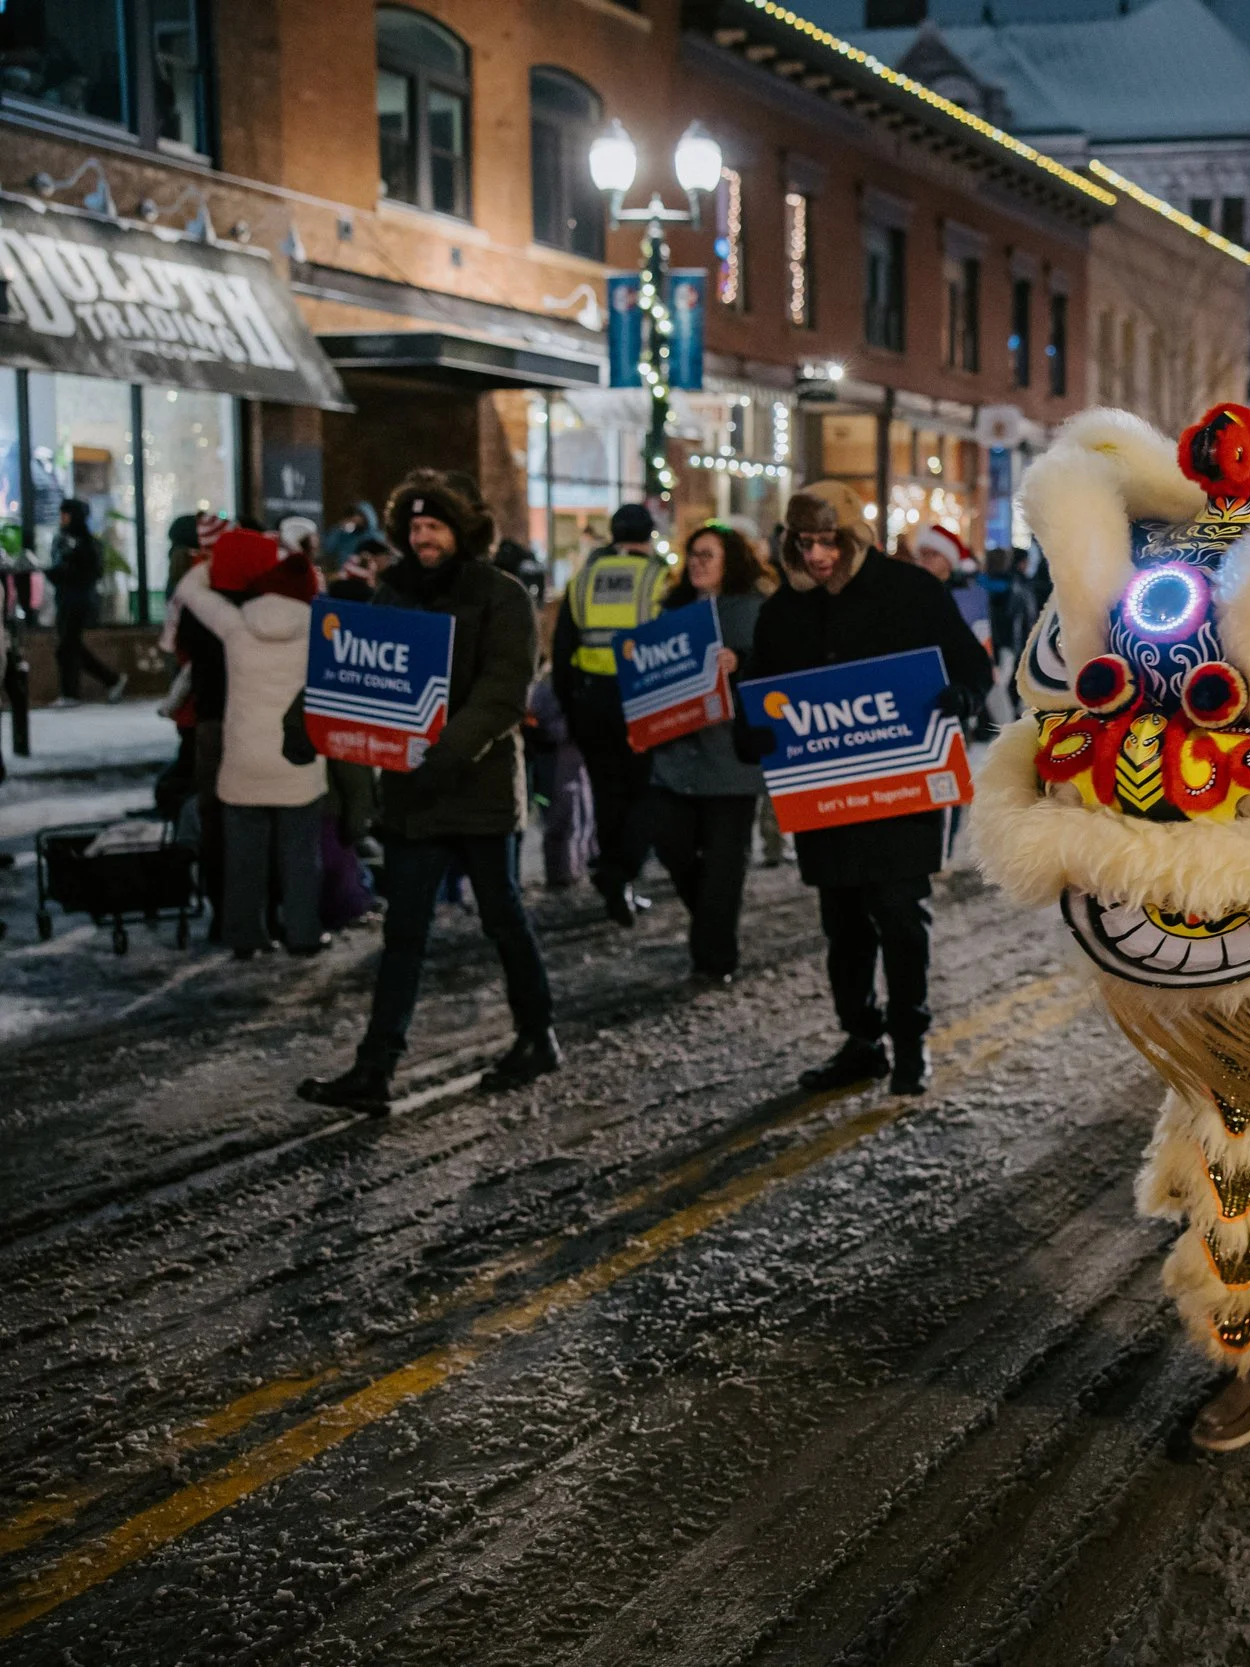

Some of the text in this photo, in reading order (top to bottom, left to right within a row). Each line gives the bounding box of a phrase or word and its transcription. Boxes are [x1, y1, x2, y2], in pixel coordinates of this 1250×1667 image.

[0, 226, 296, 371] DULUTH
[75, 300, 250, 363] TRADING
[332, 628, 410, 673] VINCE
[632, 632, 692, 673] VINCE
[338, 669, 362, 685] CITY
[363, 673, 412, 694] COUNCIL
[780, 691, 899, 736] VINCE
[786, 723, 913, 759] for CITY COUNCIL
[817, 797, 845, 814] Let's
[872, 786, 922, 804] Together
